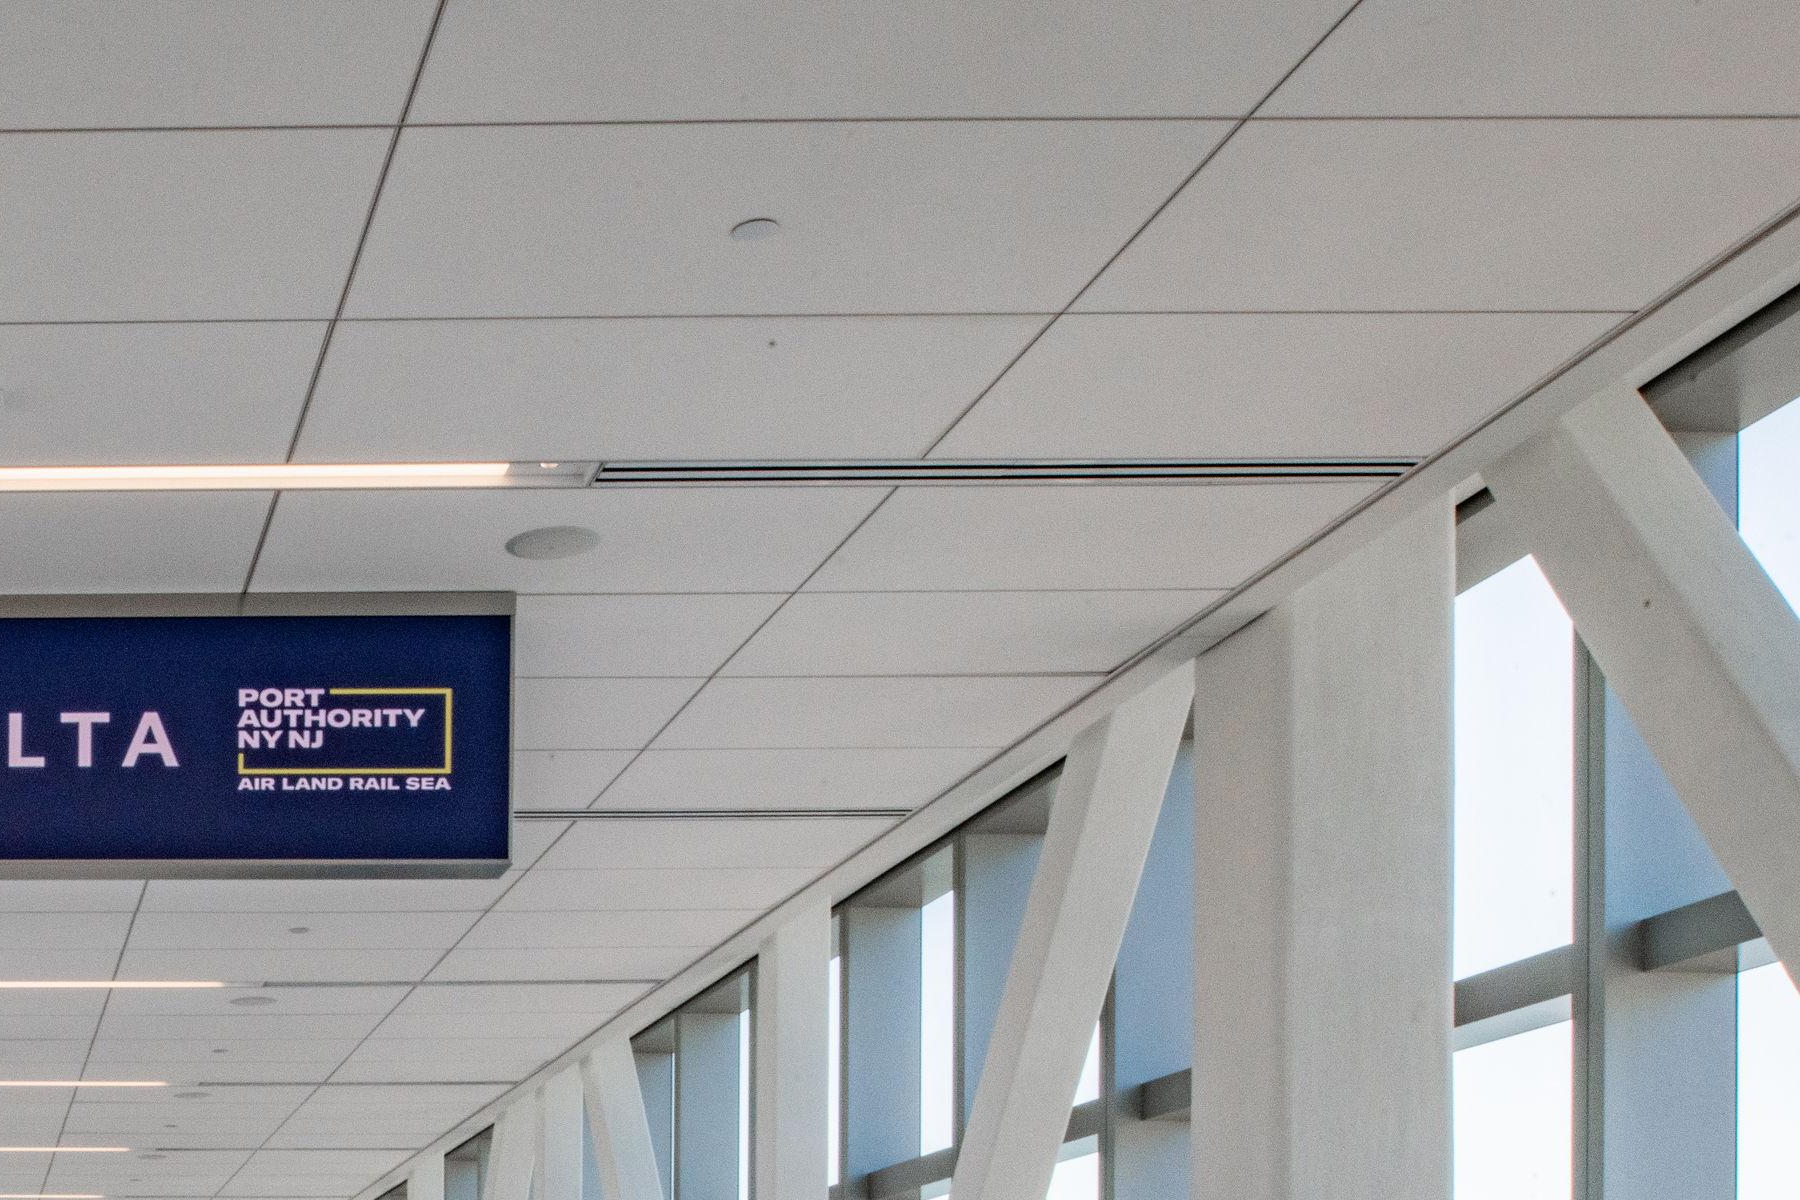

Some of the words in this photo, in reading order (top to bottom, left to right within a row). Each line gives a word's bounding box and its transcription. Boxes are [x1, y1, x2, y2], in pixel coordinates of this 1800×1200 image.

[238, 688, 325, 707] PORT
[237, 708, 425, 728] AUTHORITY
[238, 730, 283, 749] NY
[288, 730, 324, 749] NJ
[237, 777, 275, 791] AIR
[282, 777, 343, 791] LAND
[349, 777, 400, 791] RAIL
[405, 777, 452, 791] SEA
